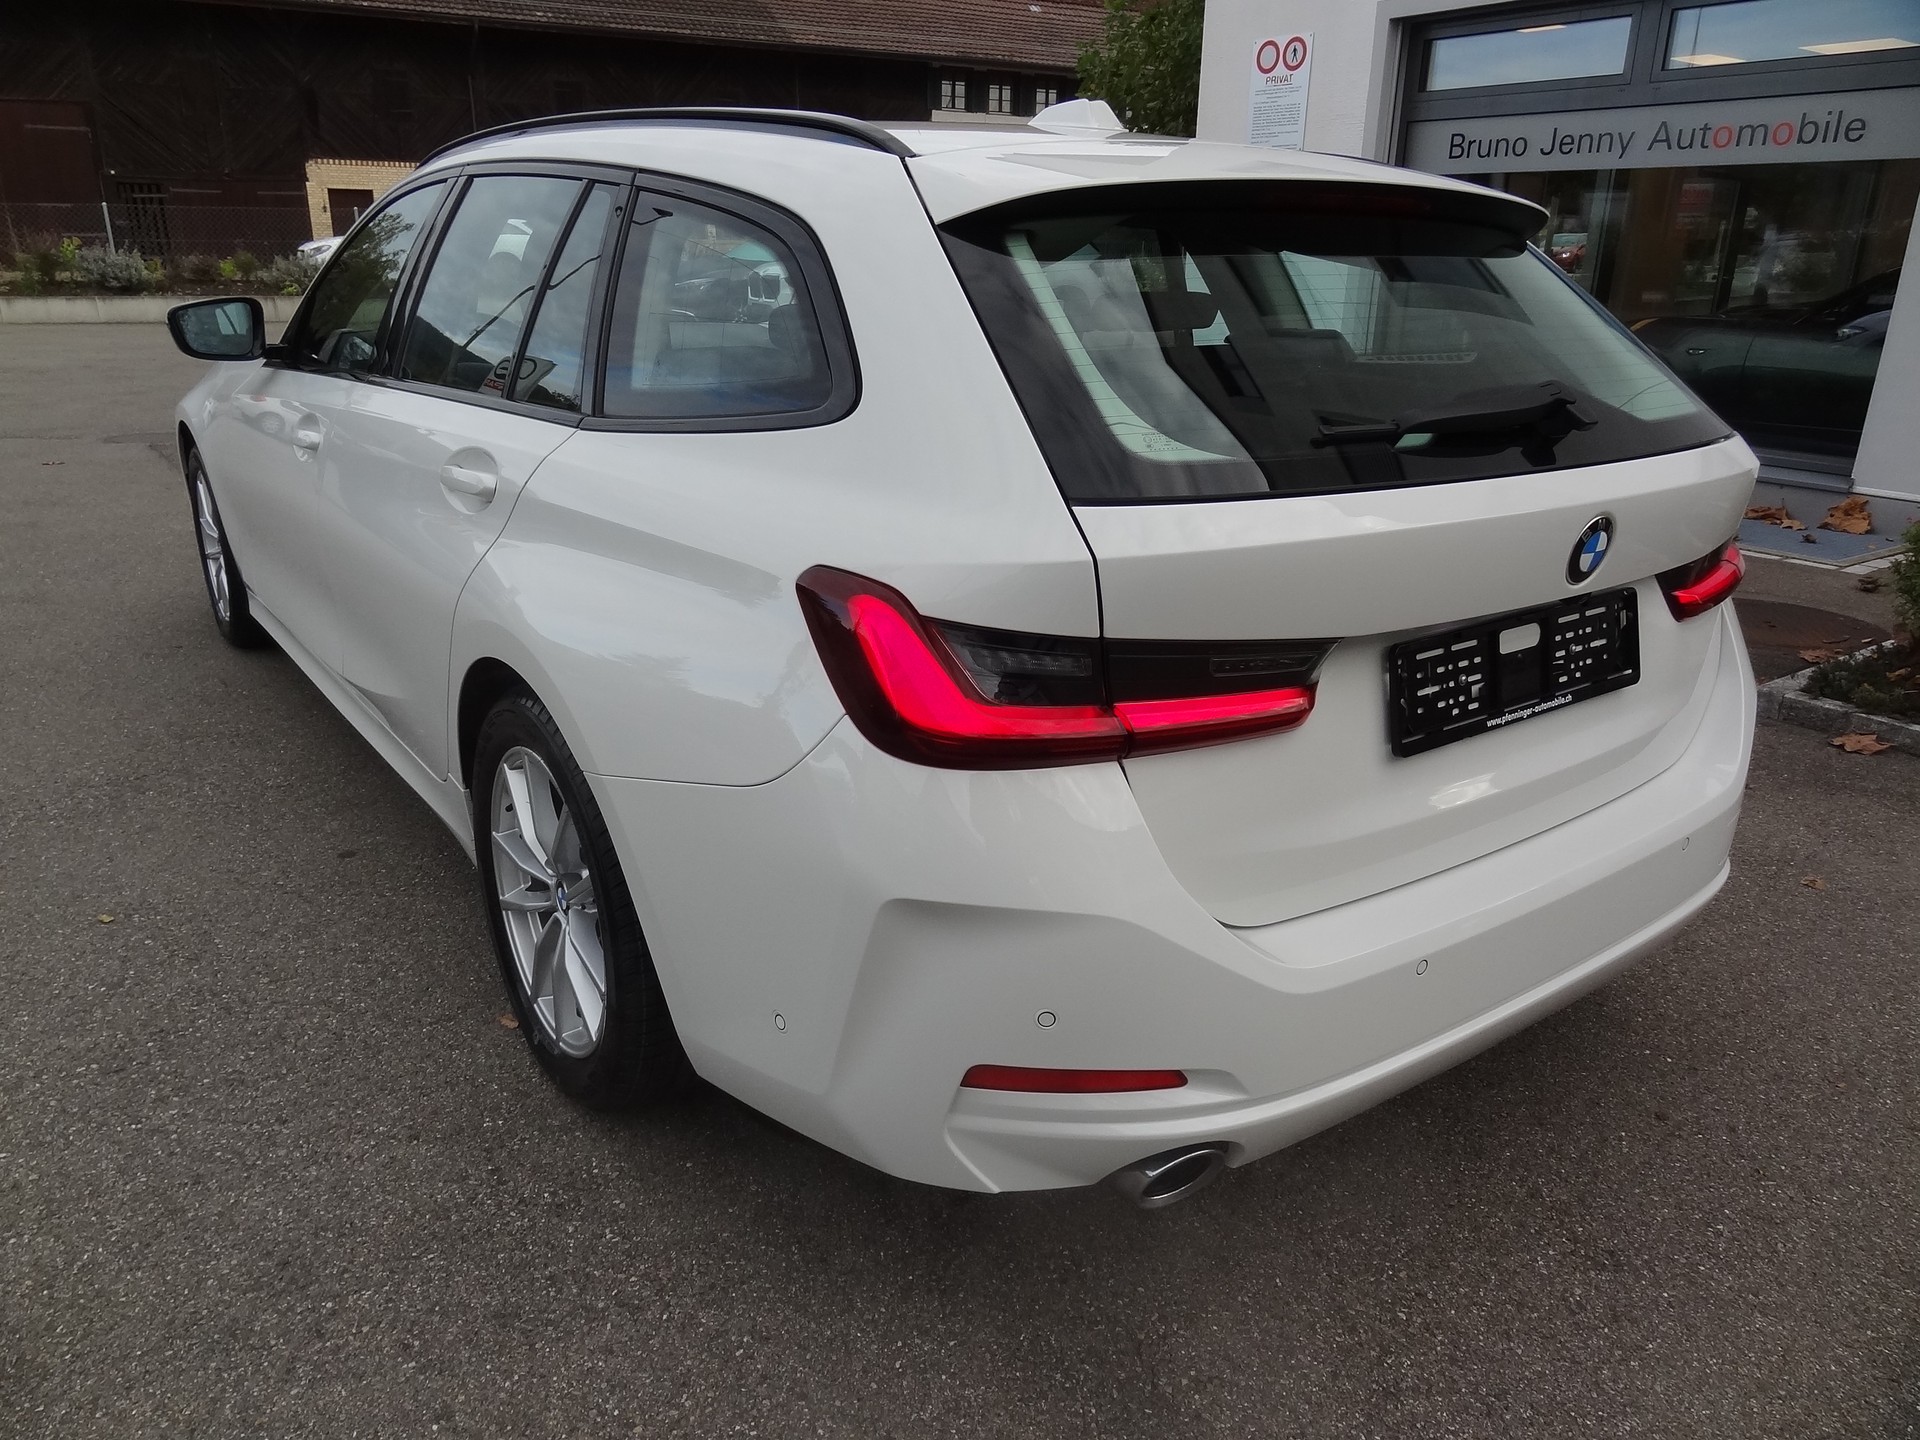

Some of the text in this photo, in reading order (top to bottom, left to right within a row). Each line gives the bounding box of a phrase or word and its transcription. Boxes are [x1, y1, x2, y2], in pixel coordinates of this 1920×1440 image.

[1265, 74, 1294, 85] PRIVAT
[1448, 110, 1867, 159] Bruno Jenny Automobile
[1486, 694, 1572, 727] www.pfenninger-automobile.ch
